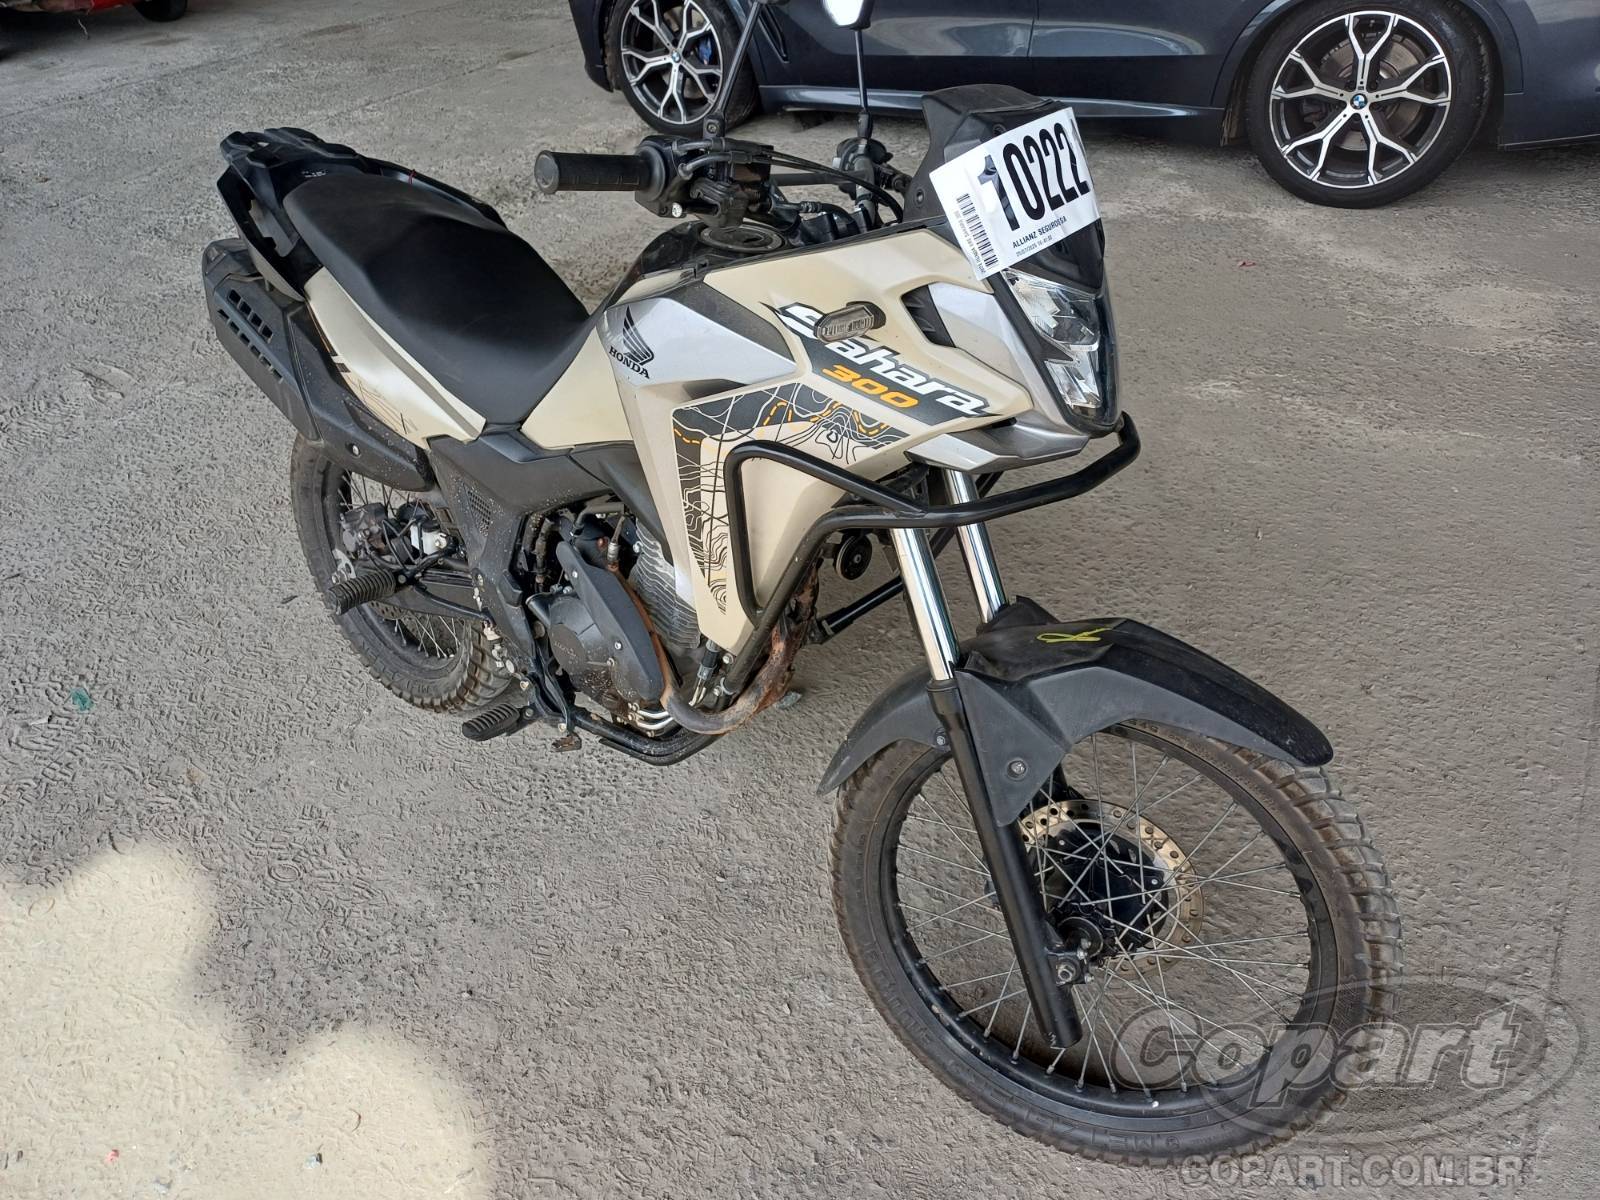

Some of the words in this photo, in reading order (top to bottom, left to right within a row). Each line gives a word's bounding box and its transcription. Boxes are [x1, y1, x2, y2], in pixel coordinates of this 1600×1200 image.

[978, 122, 1090, 231] 10222
[1012, 231, 1037, 248] ALLIANZ
[609, 346, 650, 379] HONDA
[822, 364, 919, 408] 300
